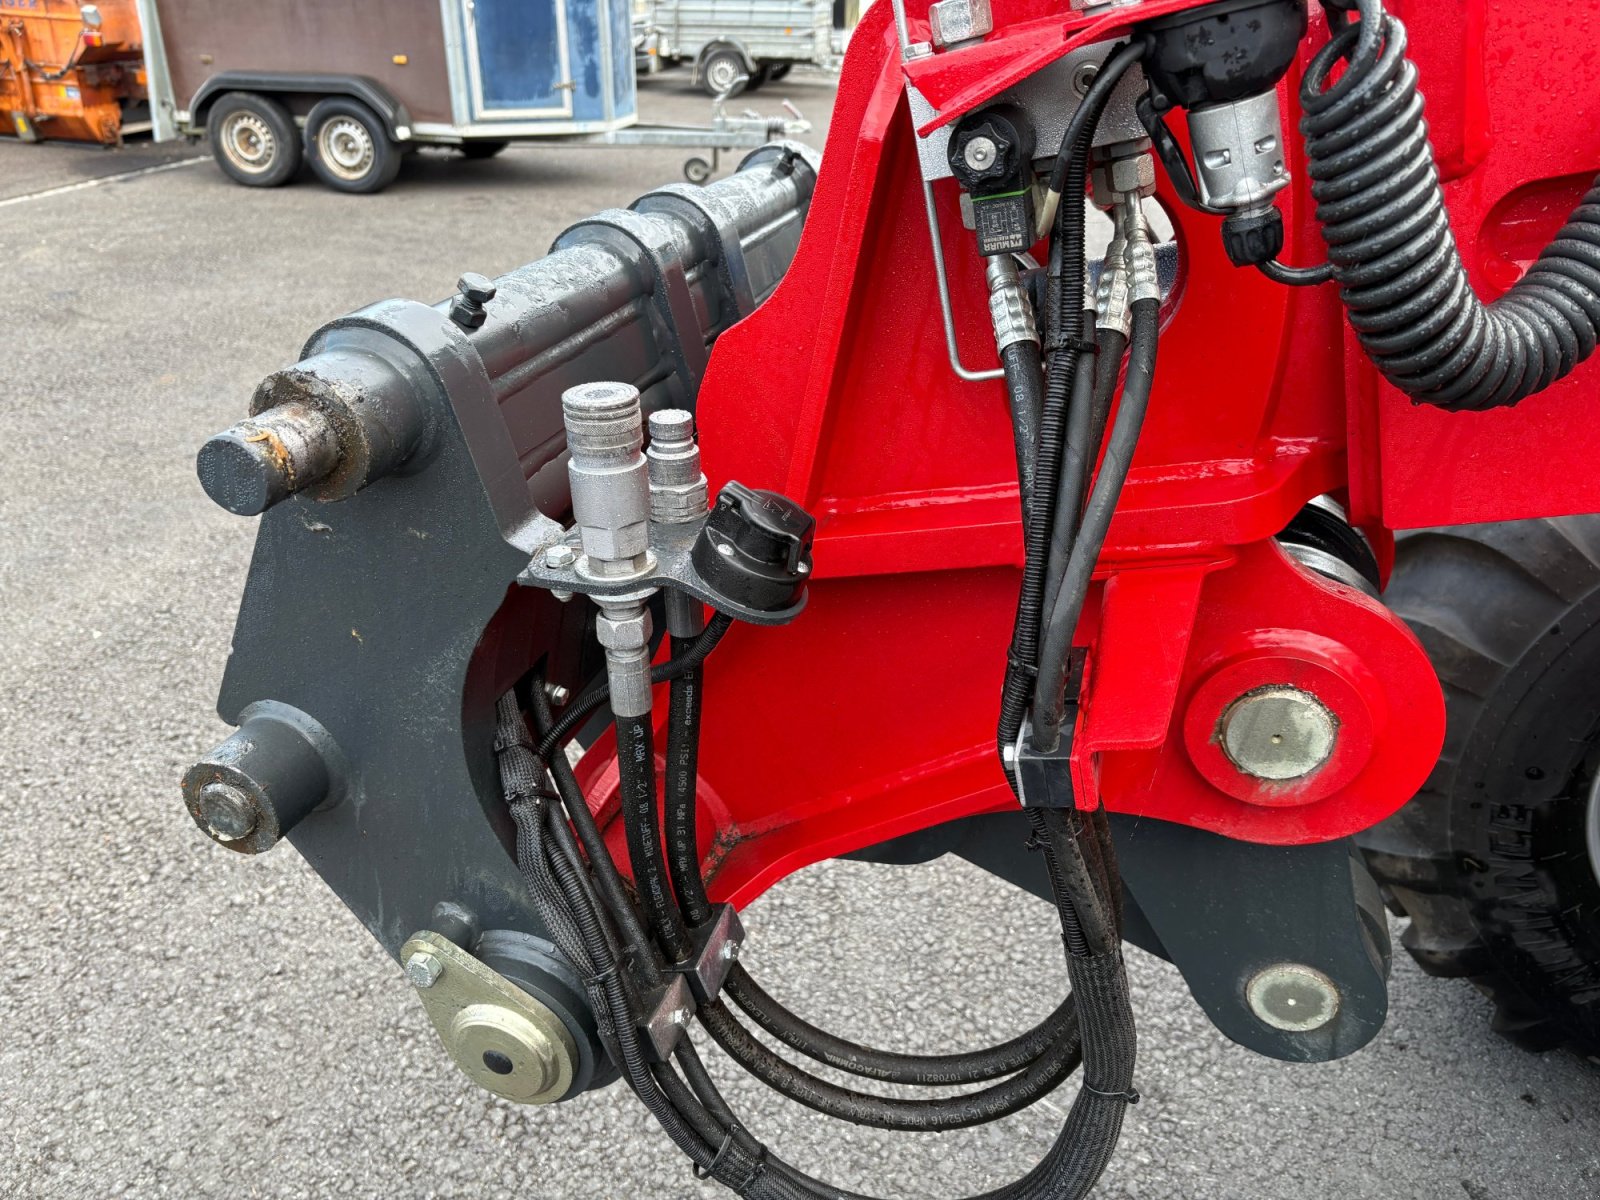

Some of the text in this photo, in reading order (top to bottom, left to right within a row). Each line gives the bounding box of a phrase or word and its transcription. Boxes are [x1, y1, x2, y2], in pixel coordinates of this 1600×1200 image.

[983, 241, 1010, 251] MURR
[1014, 385, 1025, 402] 08
[1023, 464, 1034, 489] MAX
[683, 684, 693, 726] exceeds
[634, 742, 646, 762] MAX
[678, 770, 688, 796] (4500
[639, 802, 649, 814] 08
[676, 803, 686, 820] MPa
[678, 855, 688, 872] MAX
[690, 909, 700, 921] 08
[824, 1051, 891, 1078] ALFAGOMMA
[1010, 1052, 1032, 1065] TYPE
[1036, 1059, 1062, 1086] SAE100
[1019, 1082, 1038, 1098] R16
[902, 1116, 926, 1125] MADE
